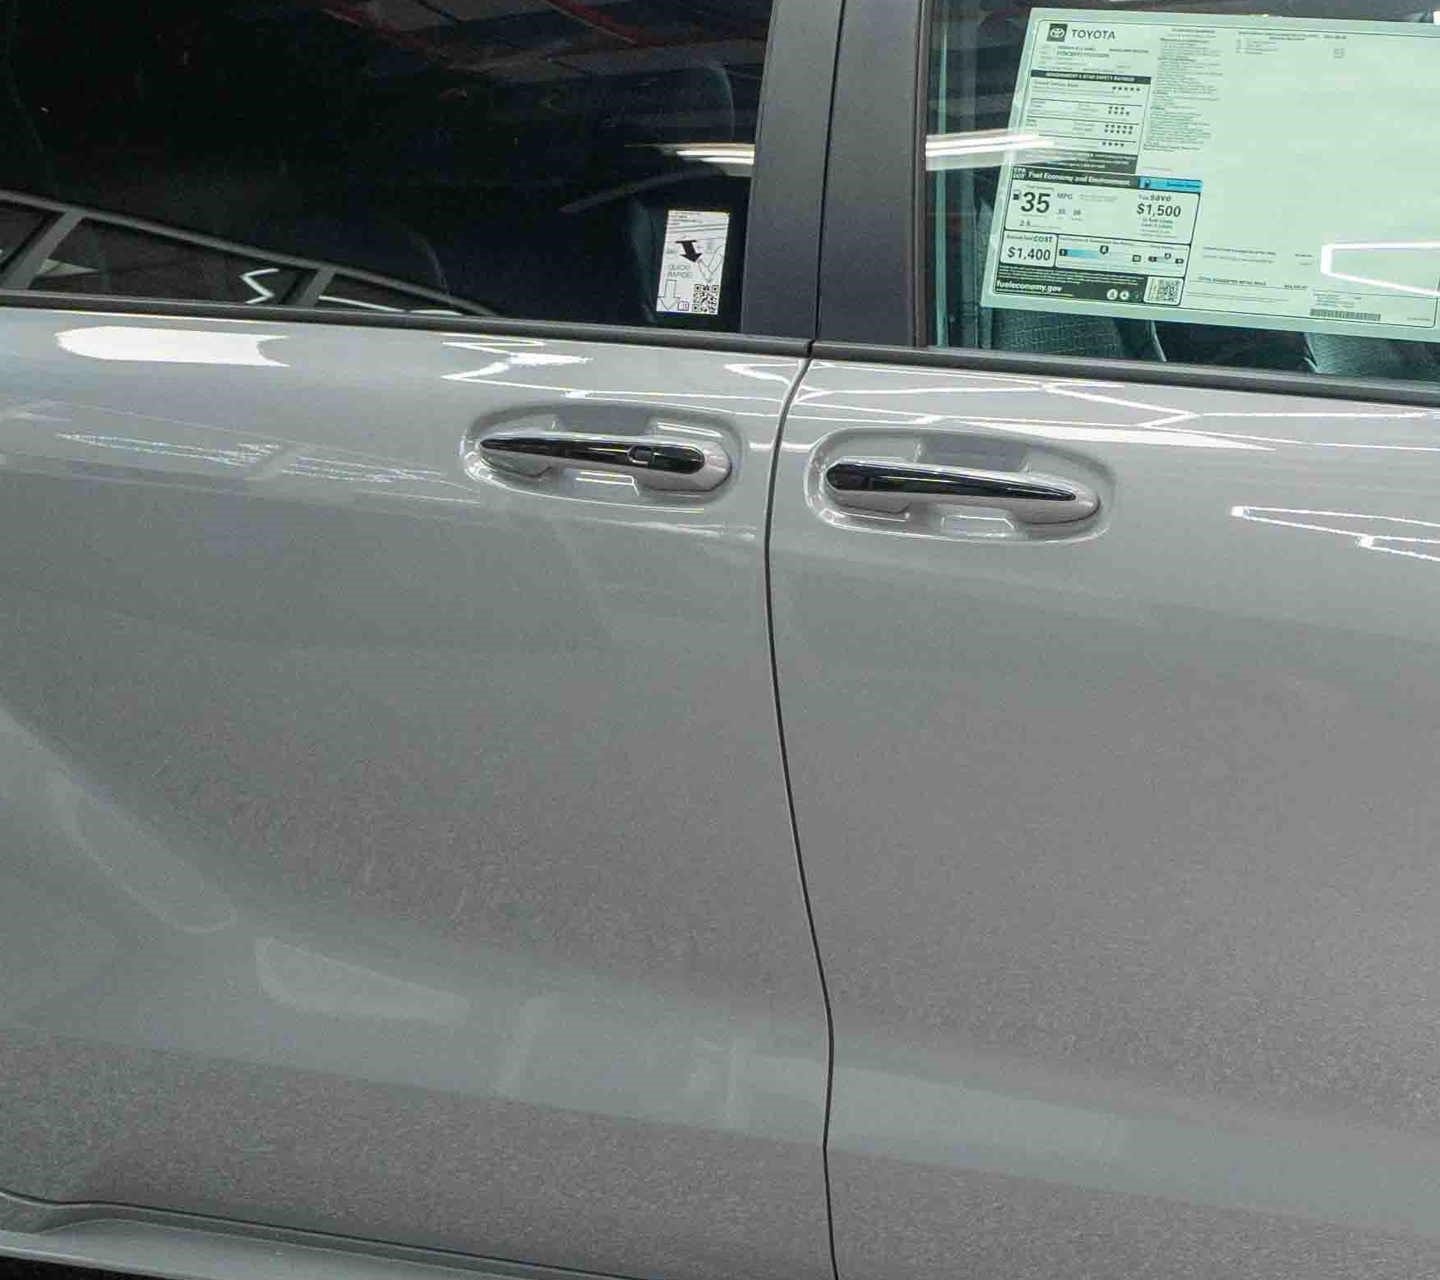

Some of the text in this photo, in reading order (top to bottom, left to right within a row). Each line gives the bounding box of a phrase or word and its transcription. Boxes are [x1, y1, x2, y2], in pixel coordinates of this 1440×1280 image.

[1071, 28, 1116, 40] TOYOTA
[1021, 192, 1051, 213] 35
[1136, 203, 1182, 218] $1,500
